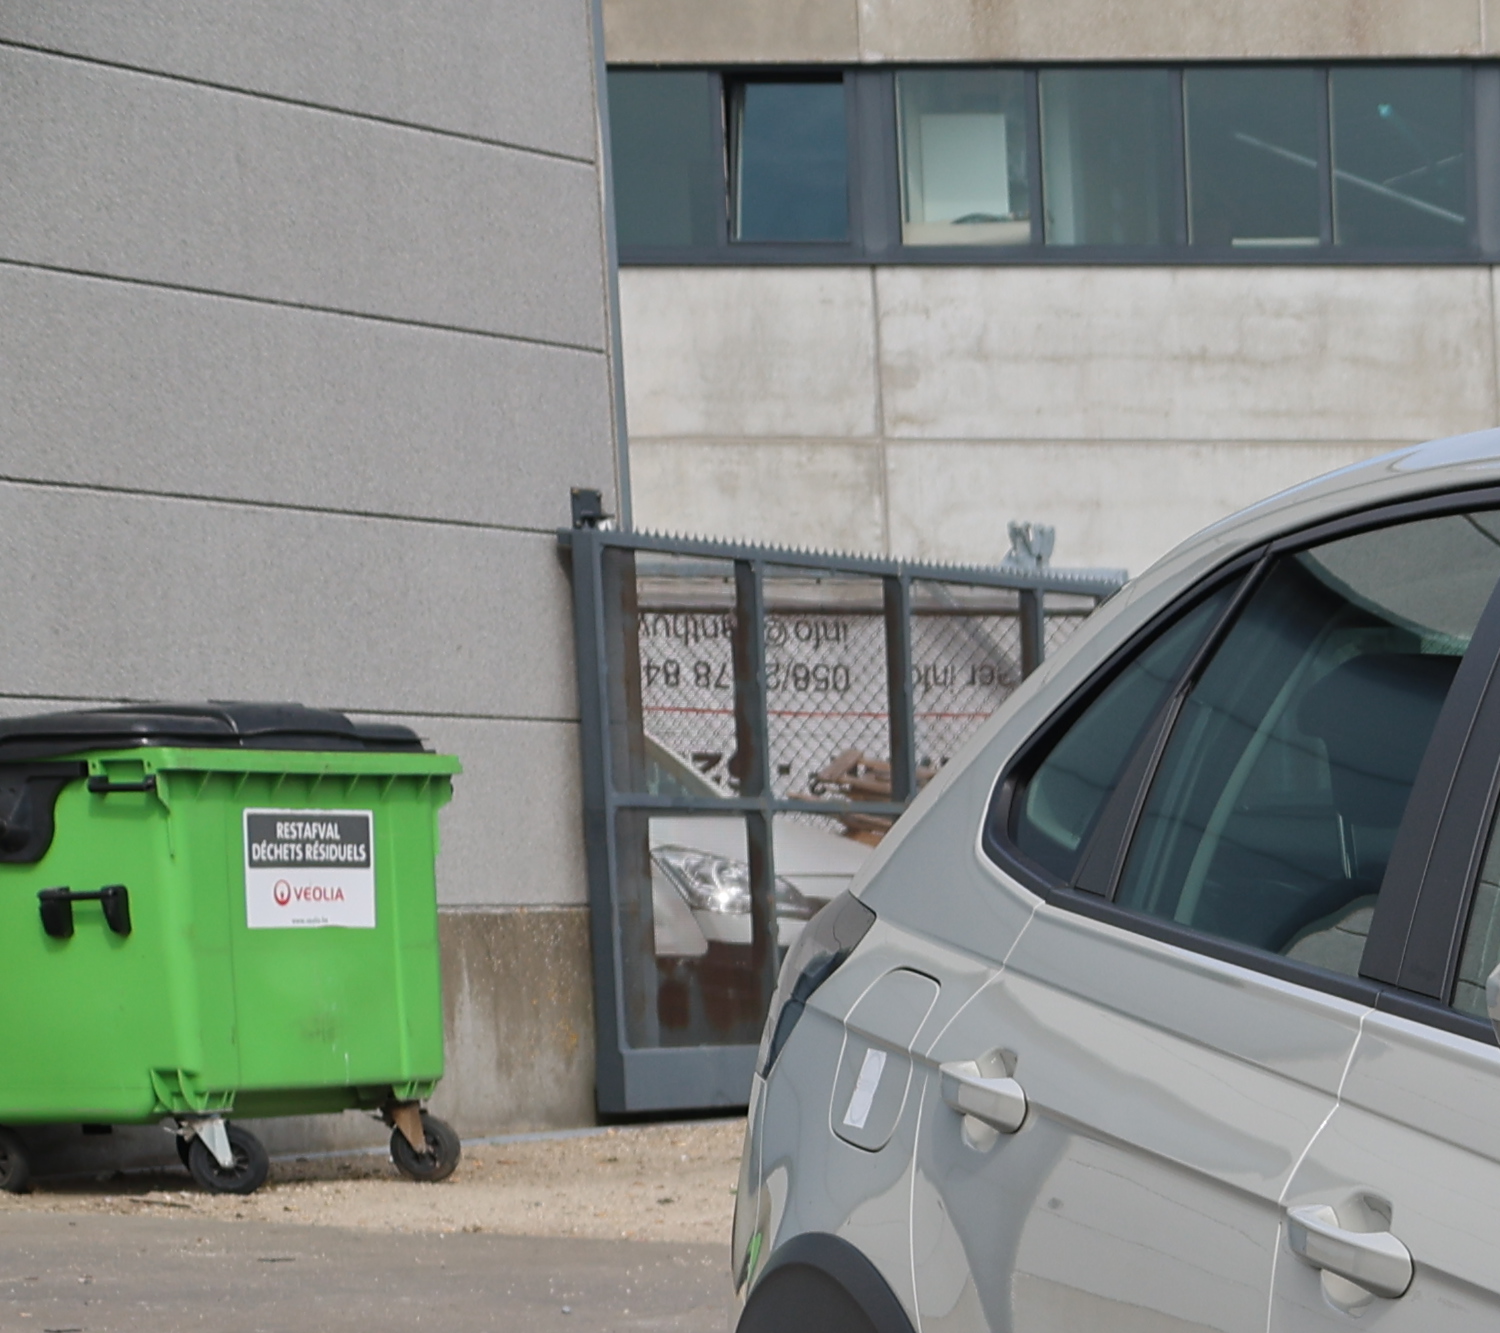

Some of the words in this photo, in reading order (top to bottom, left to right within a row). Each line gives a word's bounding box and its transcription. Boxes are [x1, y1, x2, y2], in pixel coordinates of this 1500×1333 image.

[276, 821, 341, 840] RESTAFVAL
[251, 839, 304, 861] DÉCHETS
[304, 840, 367, 862] RÉSIDUELS
[293, 885, 345, 902] VEOLIA
